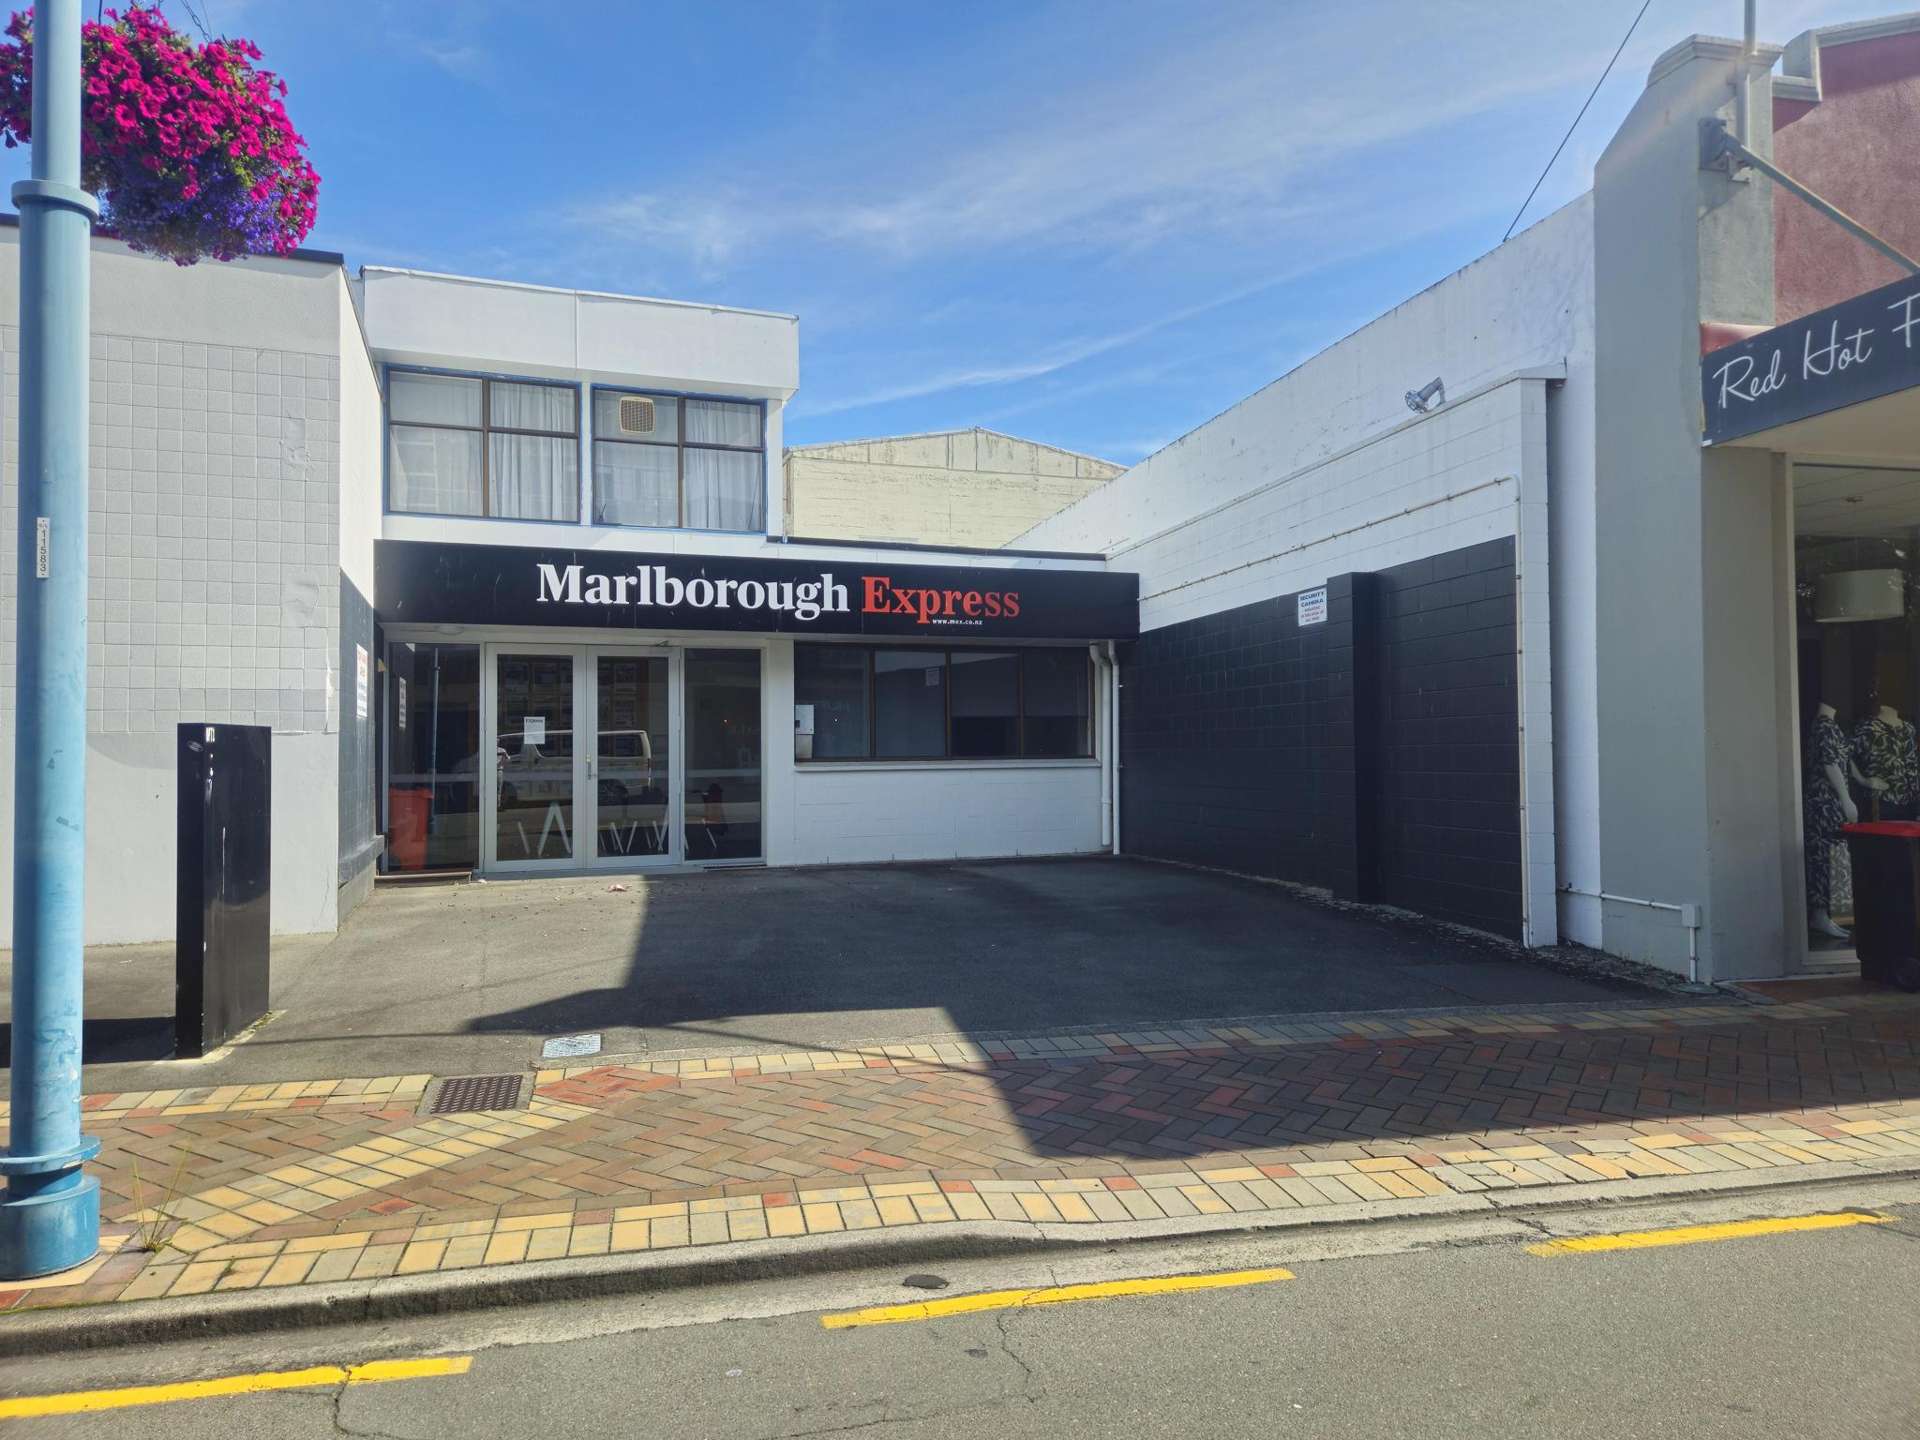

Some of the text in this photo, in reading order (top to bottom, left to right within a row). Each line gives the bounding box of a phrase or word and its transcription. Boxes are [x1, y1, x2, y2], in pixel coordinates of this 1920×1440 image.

[1713, 349, 1786, 408] Red
[1803, 320, 1875, 380] Hot
[536, 563, 1021, 625] Marlborough Express
